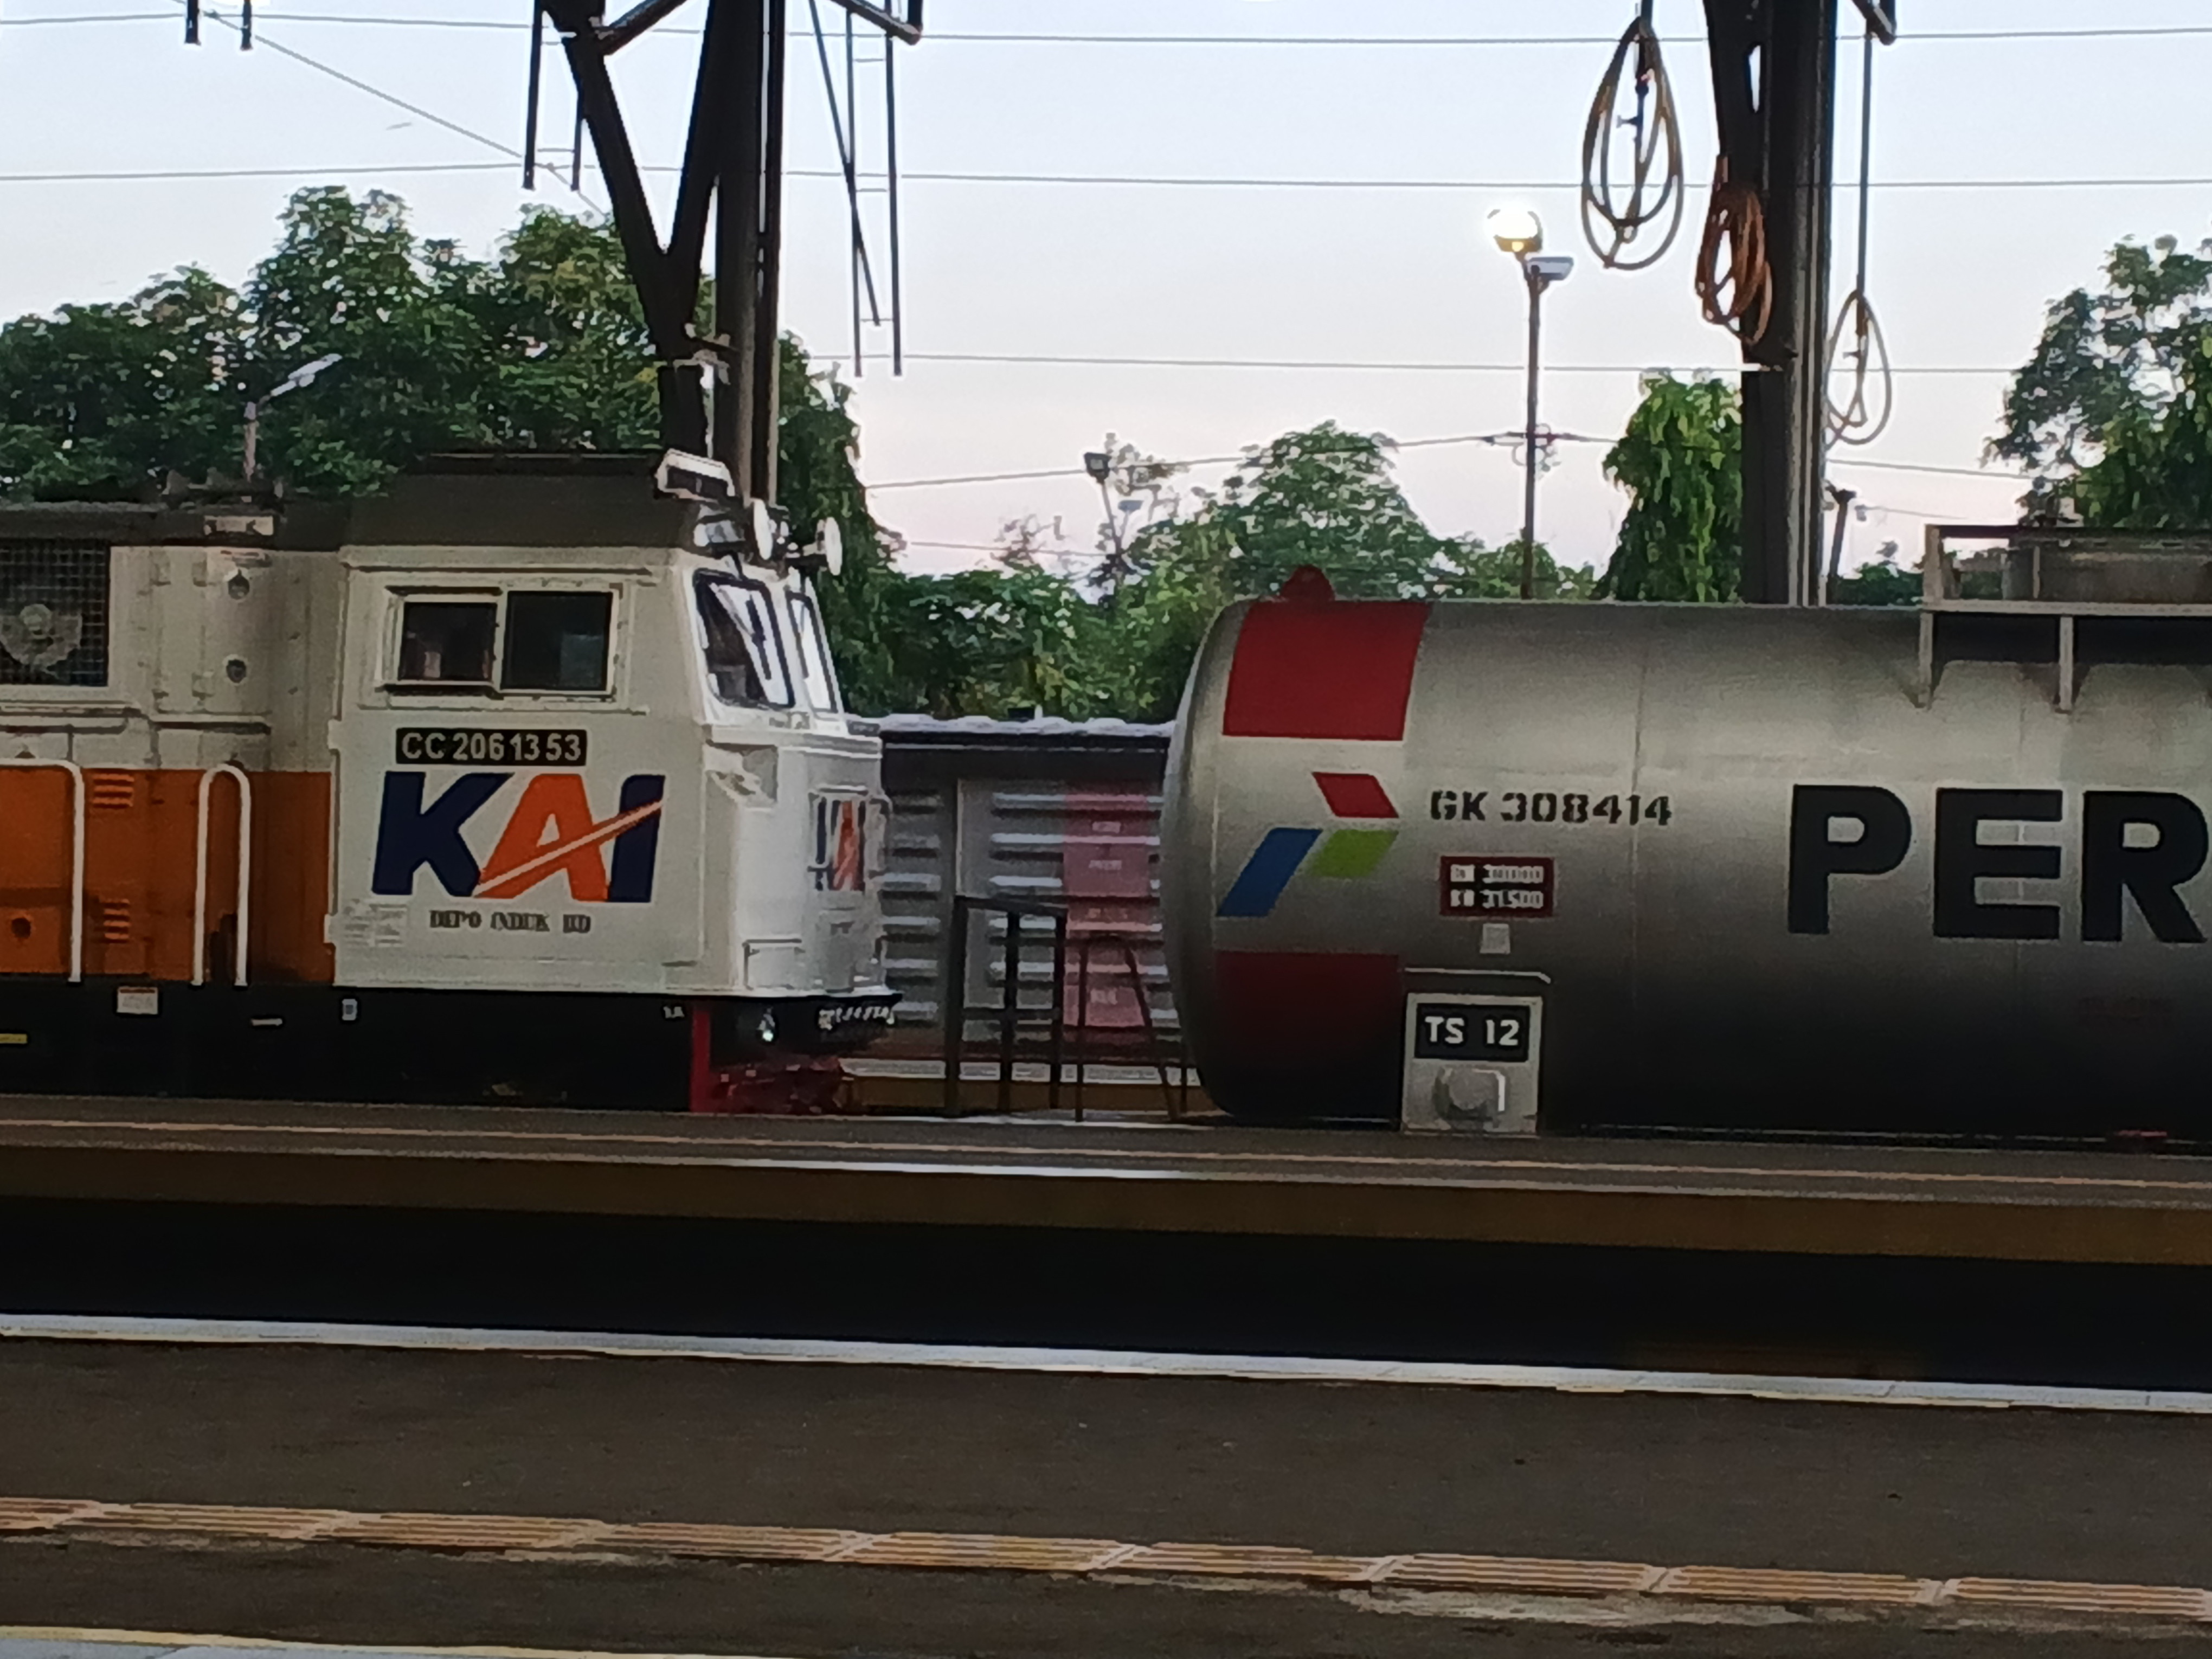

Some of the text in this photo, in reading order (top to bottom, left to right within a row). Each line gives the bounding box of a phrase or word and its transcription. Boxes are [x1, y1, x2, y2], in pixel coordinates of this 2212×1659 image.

[402, 733, 446, 758] CC
[1430, 790, 1671, 826] GK 308414
[372, 771, 666, 903] KAI
[1787, 784, 2209, 943] PER
[1425, 1016, 1520, 1046] TS 12
